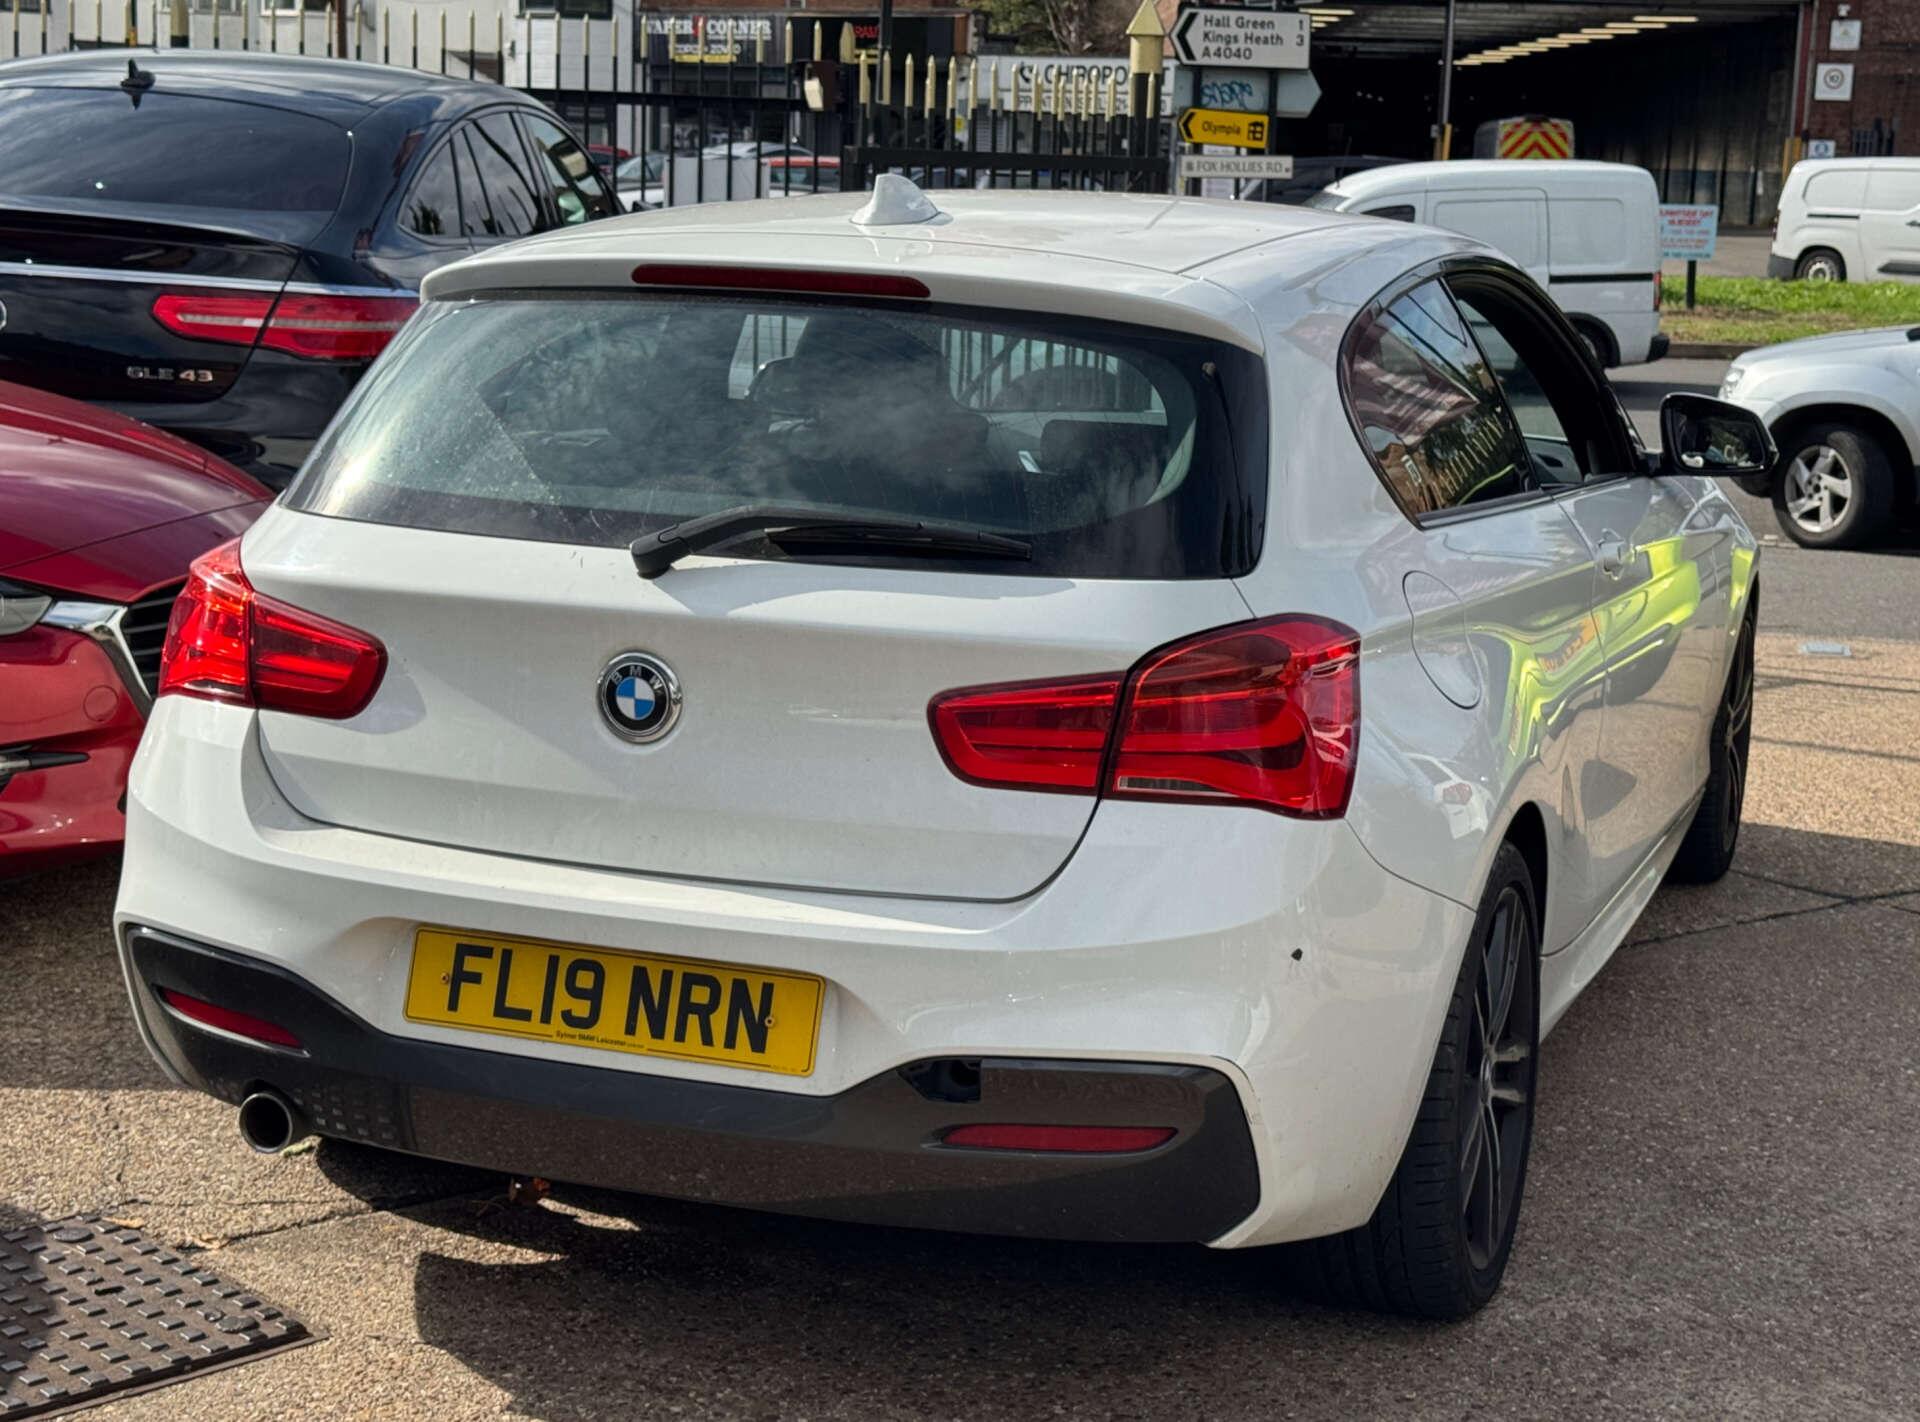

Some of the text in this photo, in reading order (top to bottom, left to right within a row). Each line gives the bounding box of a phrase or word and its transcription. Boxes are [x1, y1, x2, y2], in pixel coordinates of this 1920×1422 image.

[1203, 15, 1304, 31] Hall Green 1
[1202, 32, 1305, 47] Kings Heath 3
[1201, 47, 1253, 60] A4040
[1196, 161, 1218, 172] FOX
[1266, 162, 1283, 173] RD
[127, 366, 213, 382] GLE 43
[610, 665, 663, 690] BMW
[447, 942, 775, 1054] FL19 NRN
